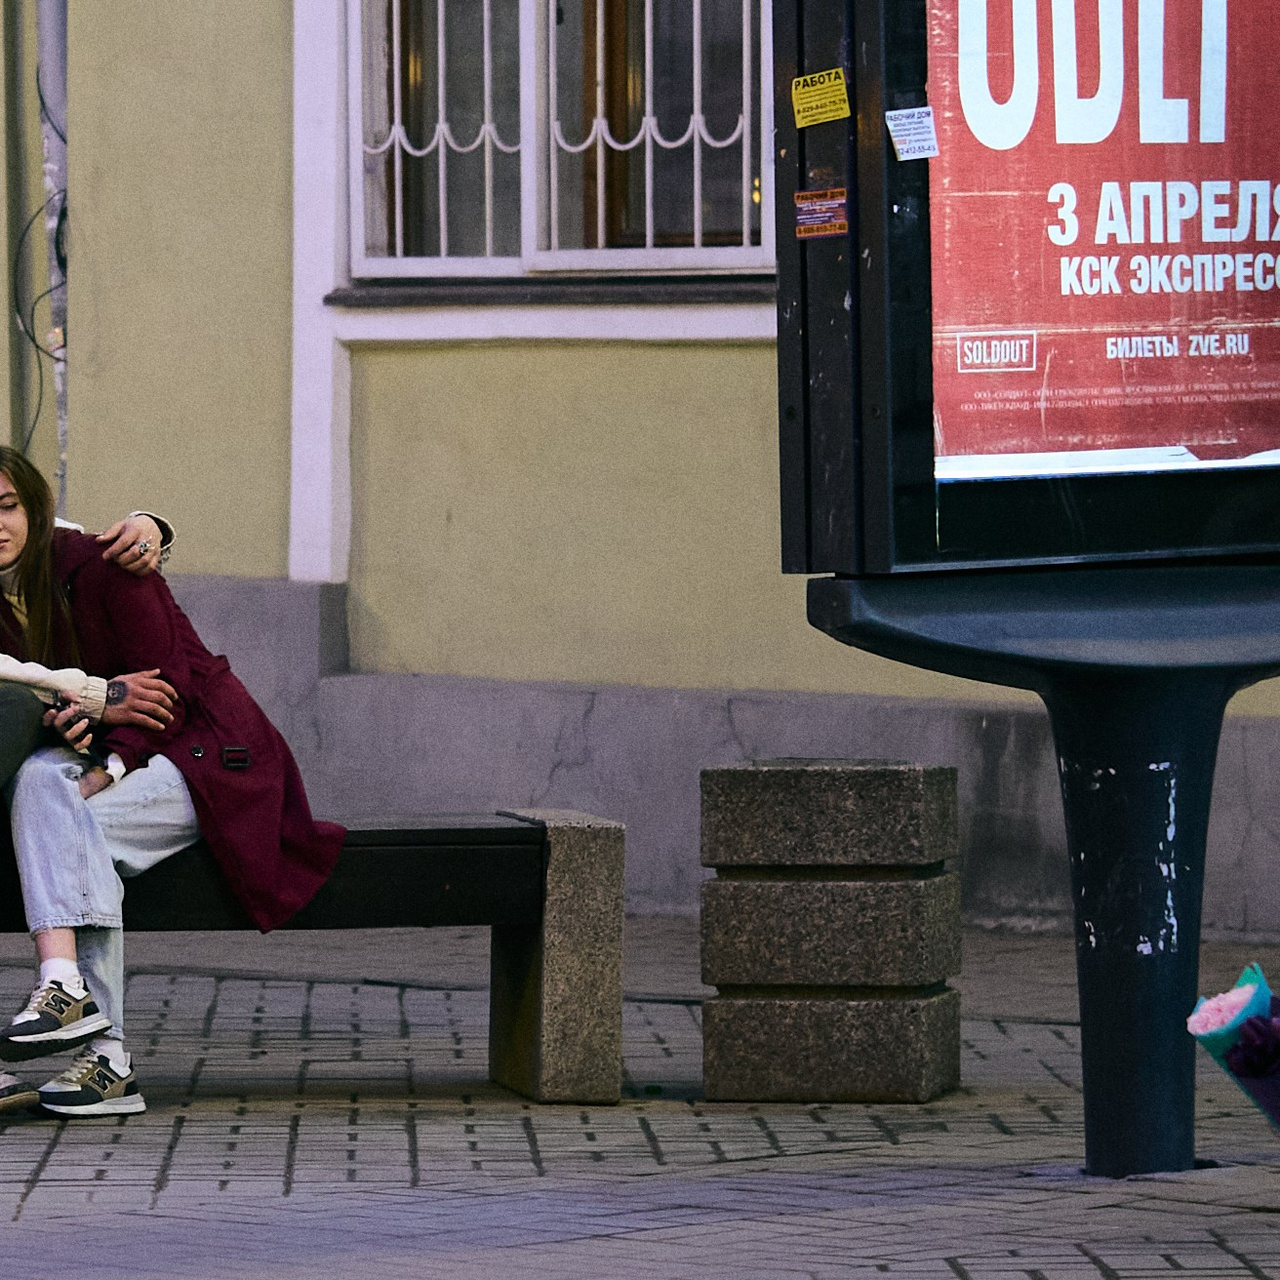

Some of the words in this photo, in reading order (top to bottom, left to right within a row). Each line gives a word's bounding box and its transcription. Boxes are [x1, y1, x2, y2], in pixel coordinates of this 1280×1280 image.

[795, 71, 842, 90] РАБОТА
[1047, 182, 1079, 246] 3
[1060, 255, 1122, 296] КСК
[1130, 253, 1280, 294] ЭКСПРЕС
[963, 339, 1029, 364] SOLDOUT
[1106, 335, 1179, 359] БИЛЕТЫ
[1188, 333, 1250, 356] ZVE.RU
